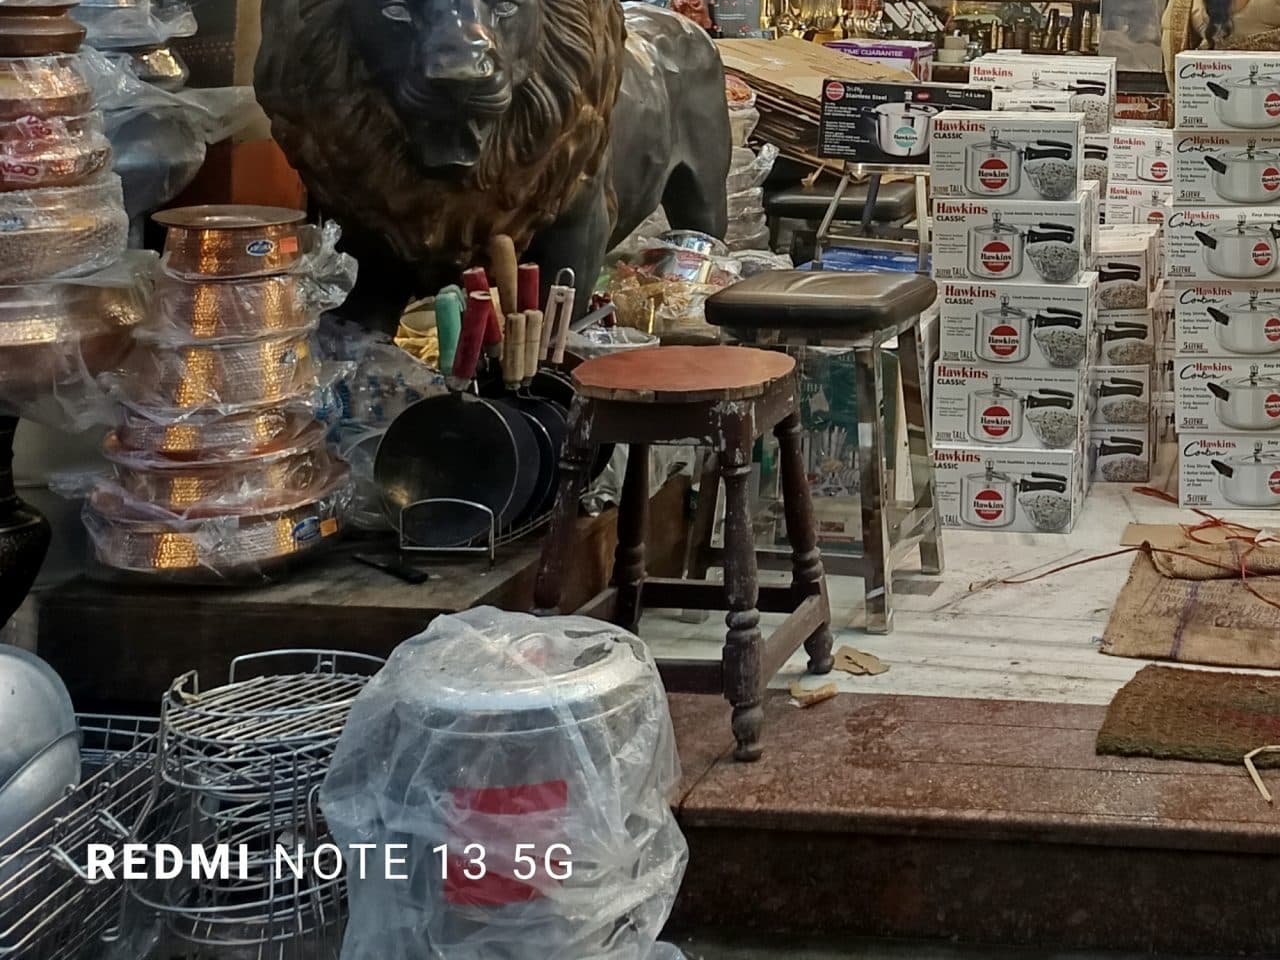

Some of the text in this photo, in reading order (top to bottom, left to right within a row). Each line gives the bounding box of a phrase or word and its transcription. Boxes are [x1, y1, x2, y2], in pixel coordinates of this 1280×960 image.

[860, 49, 904, 57] GUARANTEE
[1195, 61, 1232, 71] Hawkins
[973, 66, 1013, 77] Hawkins
[933, 120, 986, 132] Hawkins
[1113, 137, 1146, 146] Hawkins
[1193, 136, 1230, 145] Hawkins
[1109, 187, 1142, 196] Hawkins
[936, 202, 989, 215] Hawkins
[1183, 211, 1220, 220] Hawkins
[980, 253, 1012, 261] Hawkins
[945, 285, 997, 298] Hawkins
[1195, 287, 1232, 296] Hawkins
[988, 336, 1019, 344] Hawkins
[1195, 362, 1232, 372] Hawkins
[937, 366, 989, 379] Hawkins
[980, 417, 1012, 425] Hawkins
[1199, 440, 1237, 449] Hawkins
[973, 501, 1005, 509] Hawkins
